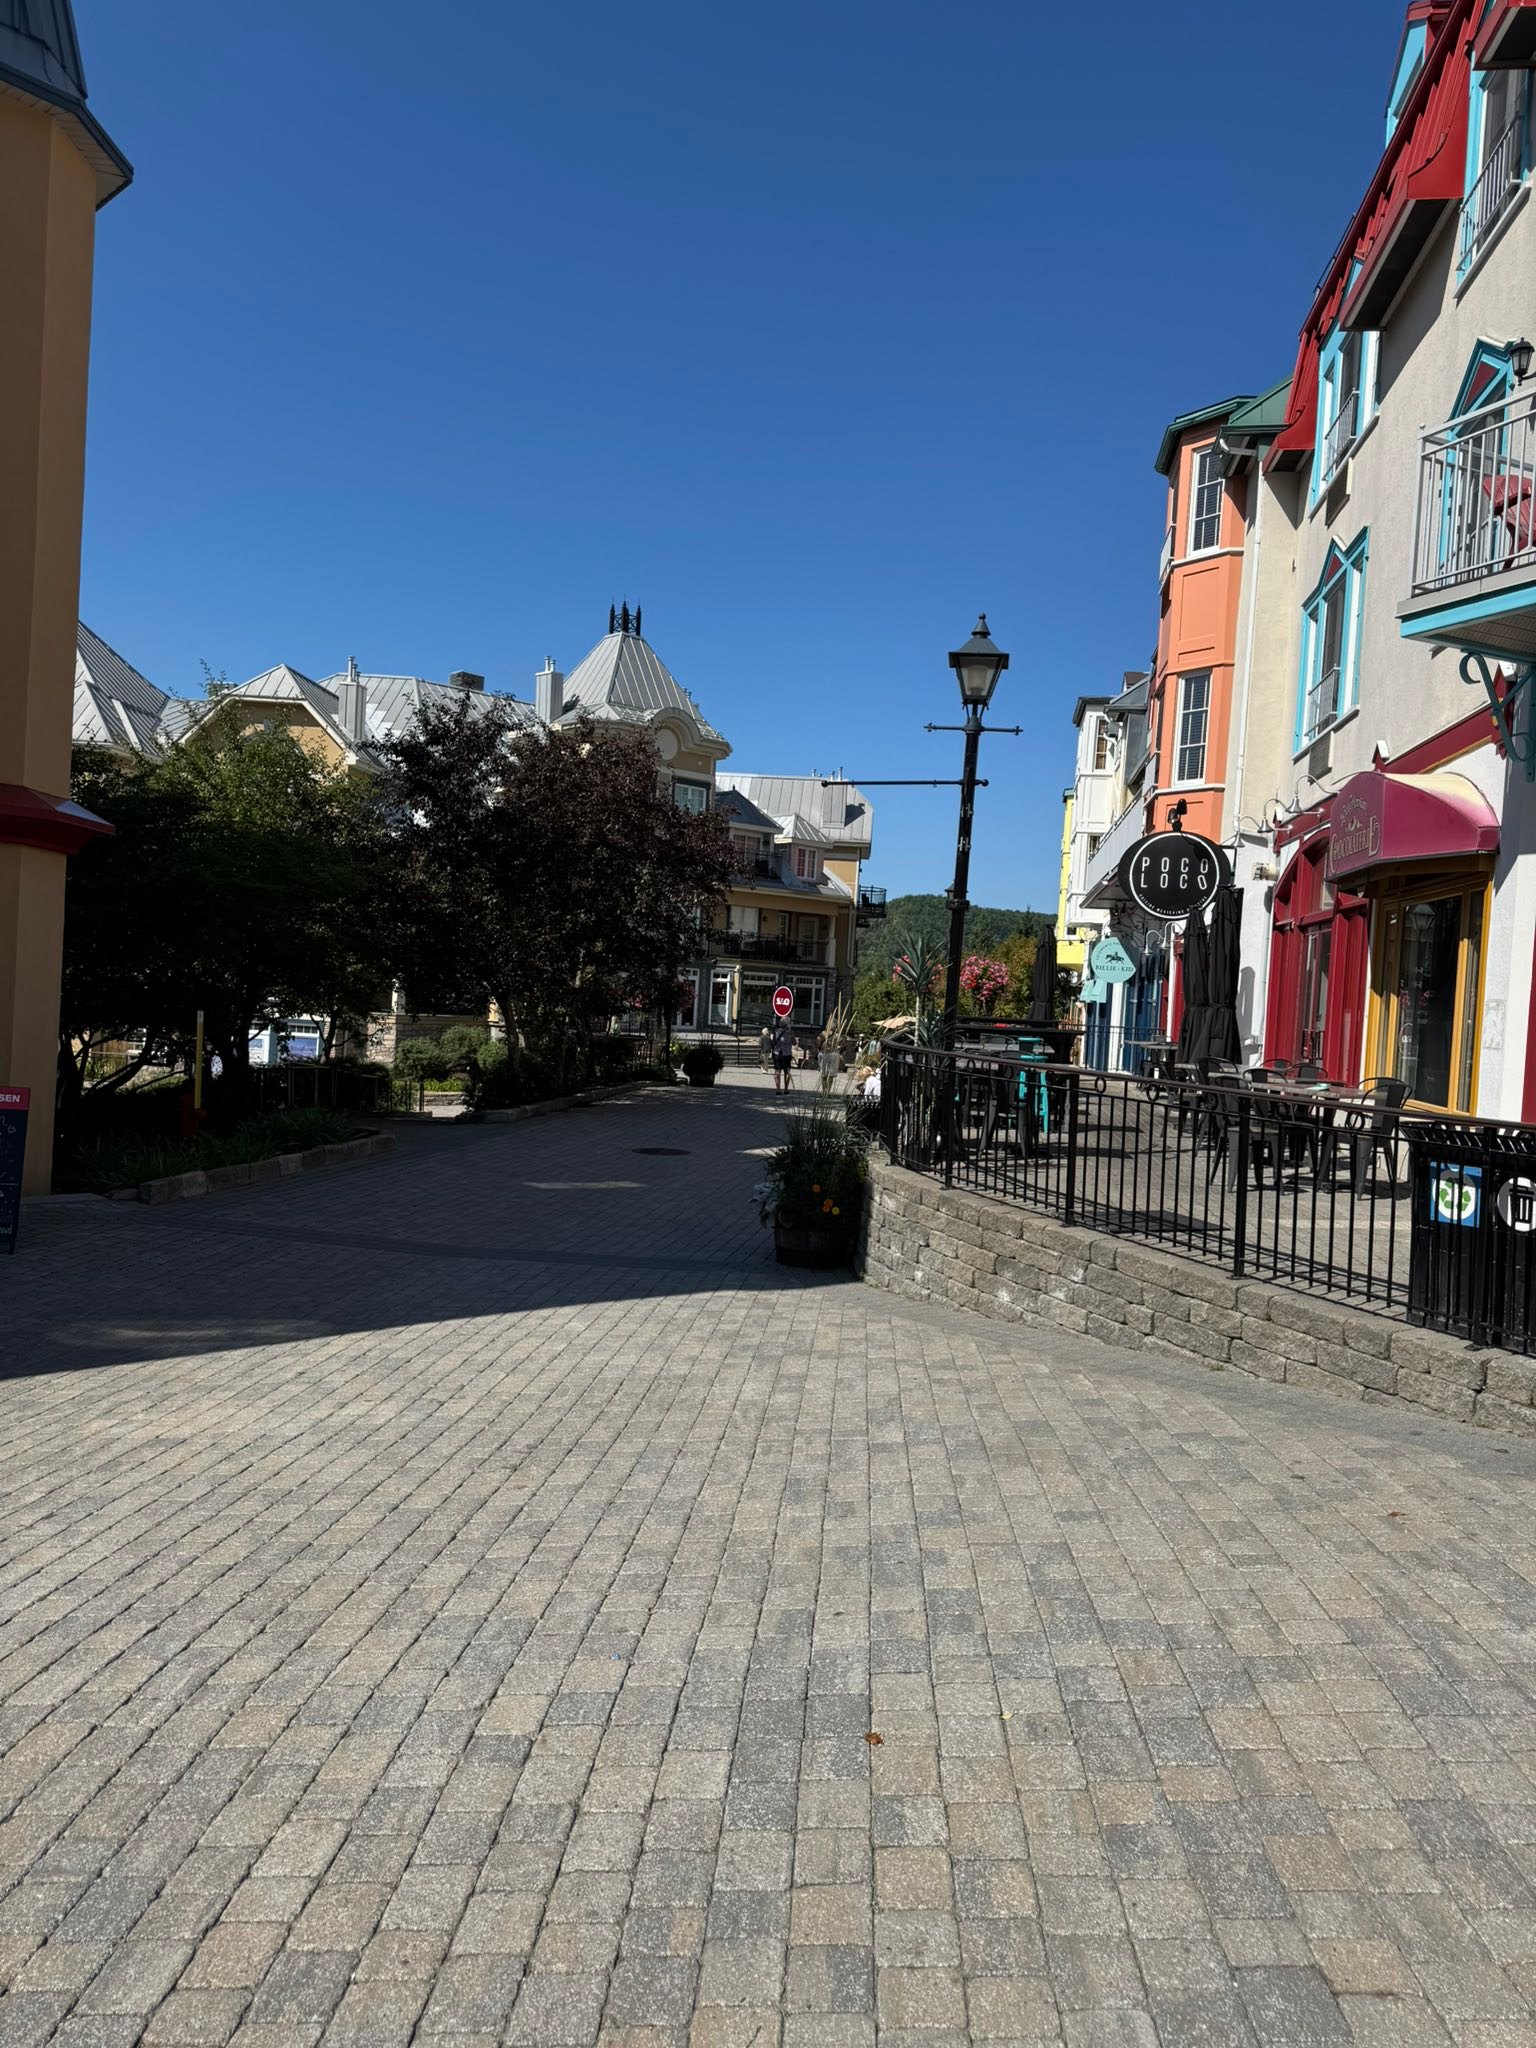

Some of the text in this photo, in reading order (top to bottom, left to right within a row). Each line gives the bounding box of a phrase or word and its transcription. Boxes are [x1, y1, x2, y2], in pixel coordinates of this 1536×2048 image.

[1141, 856, 1209, 874] POCO
[1140, 873, 1208, 890] LOCO
[1095, 964, 1117, 972] BILLIE
